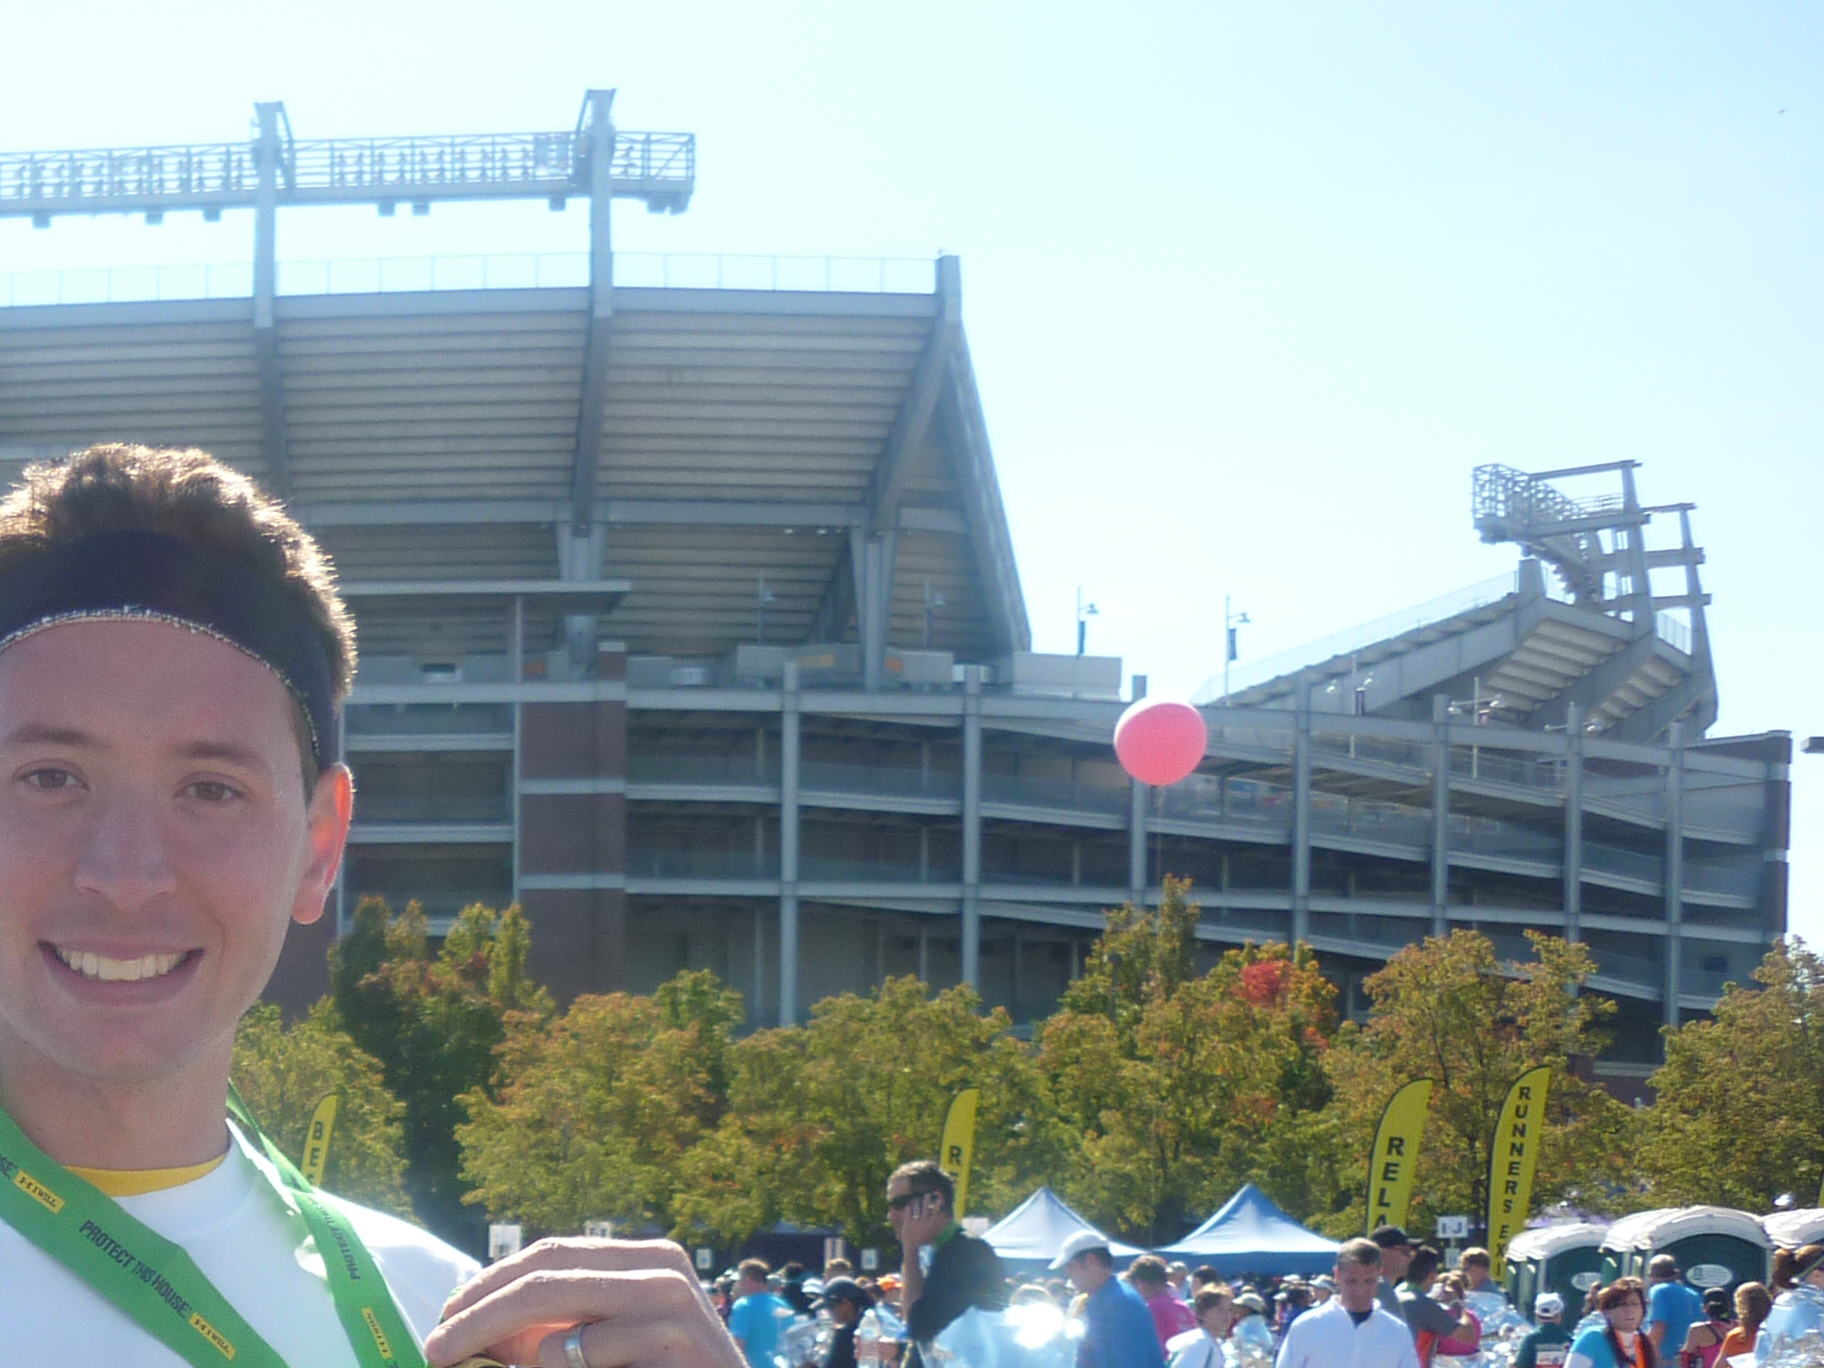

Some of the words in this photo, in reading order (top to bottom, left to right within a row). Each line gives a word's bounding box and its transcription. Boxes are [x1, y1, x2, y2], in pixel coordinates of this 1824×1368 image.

[1503, 1086, 1531, 1214] RUNNERS
[78, 1218, 135, 1268] PROTECT
[131, 1259, 155, 1284] THIS
